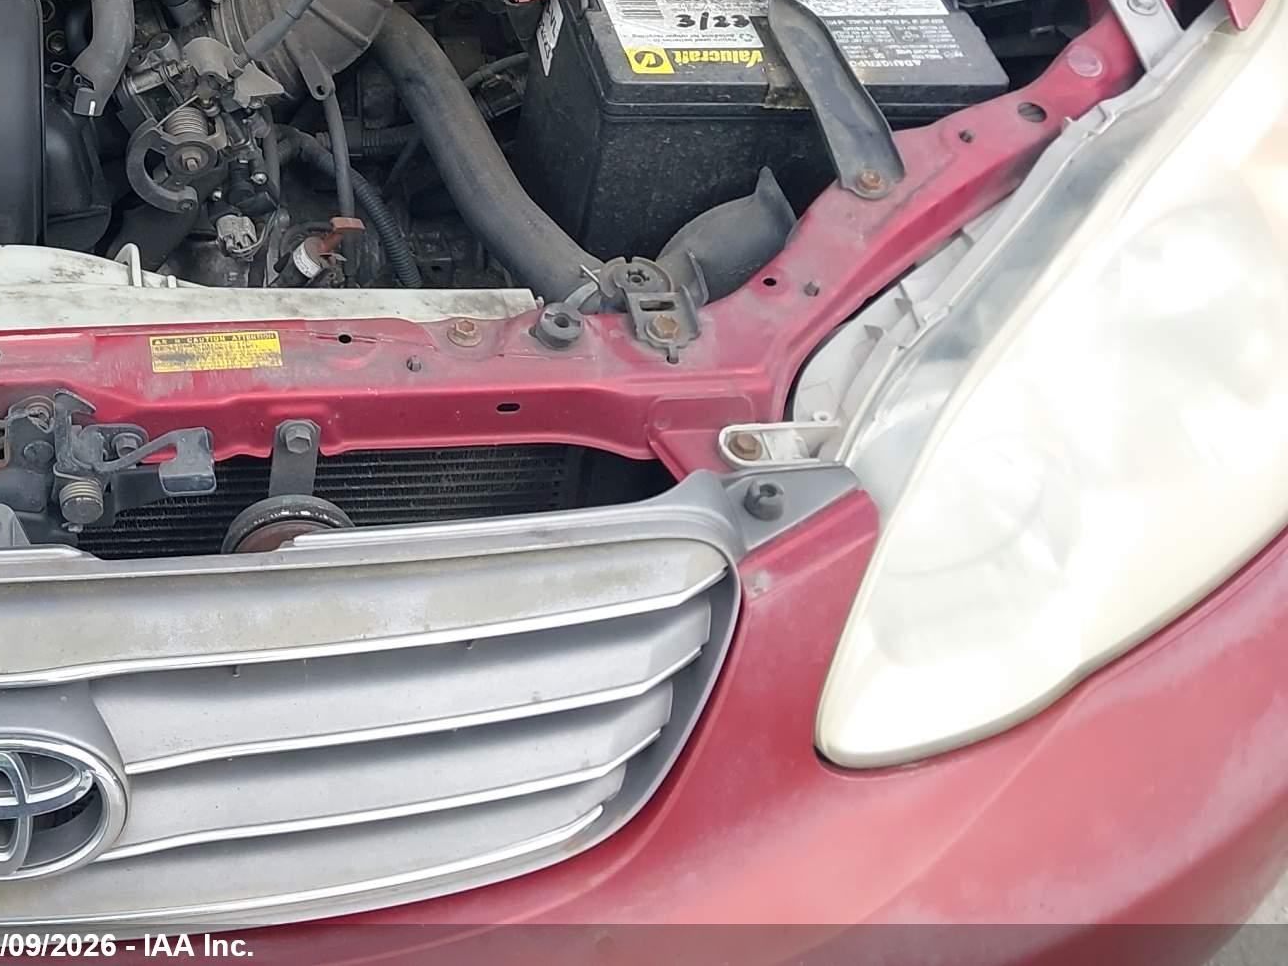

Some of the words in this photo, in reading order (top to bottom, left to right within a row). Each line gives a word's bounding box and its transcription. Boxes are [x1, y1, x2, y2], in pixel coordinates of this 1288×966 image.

[675, 12, 750, 30] 3/23
[674, 50, 764, 68] Valucraft
[186, 335, 226, 344] CAUTION
